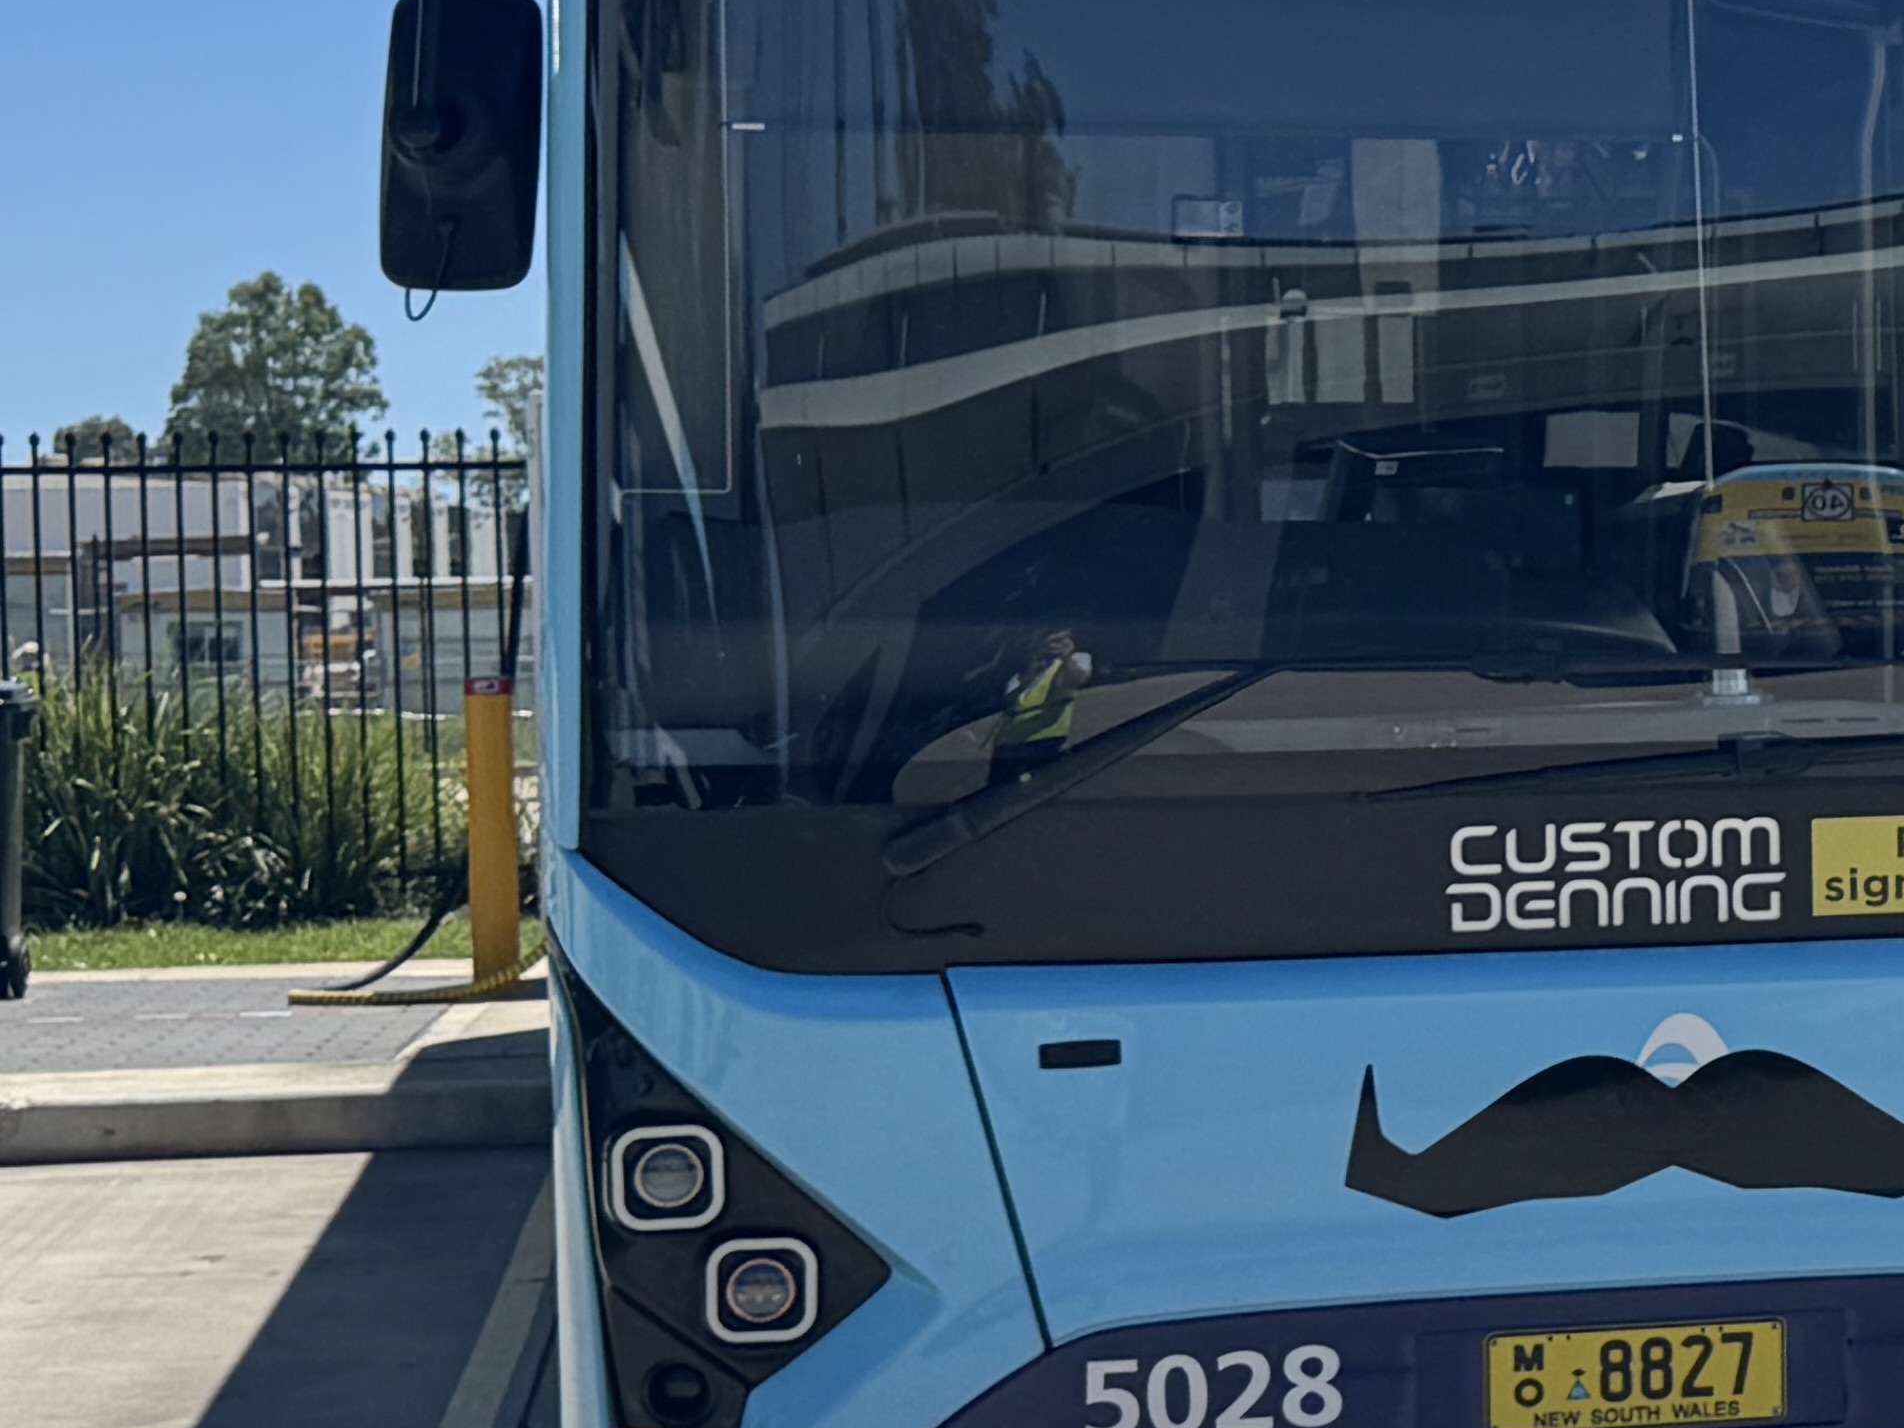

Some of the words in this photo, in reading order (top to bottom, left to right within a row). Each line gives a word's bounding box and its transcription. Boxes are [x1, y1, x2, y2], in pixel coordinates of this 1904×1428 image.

[1449, 816, 1782, 875] CUSTOM
[1445, 872, 1787, 933] DENNING
[1599, 1332, 1755, 1403] 8827
[1590, 1405, 1666, 1427] SOUTH
[1672, 1400, 1740, 1422] WALES
